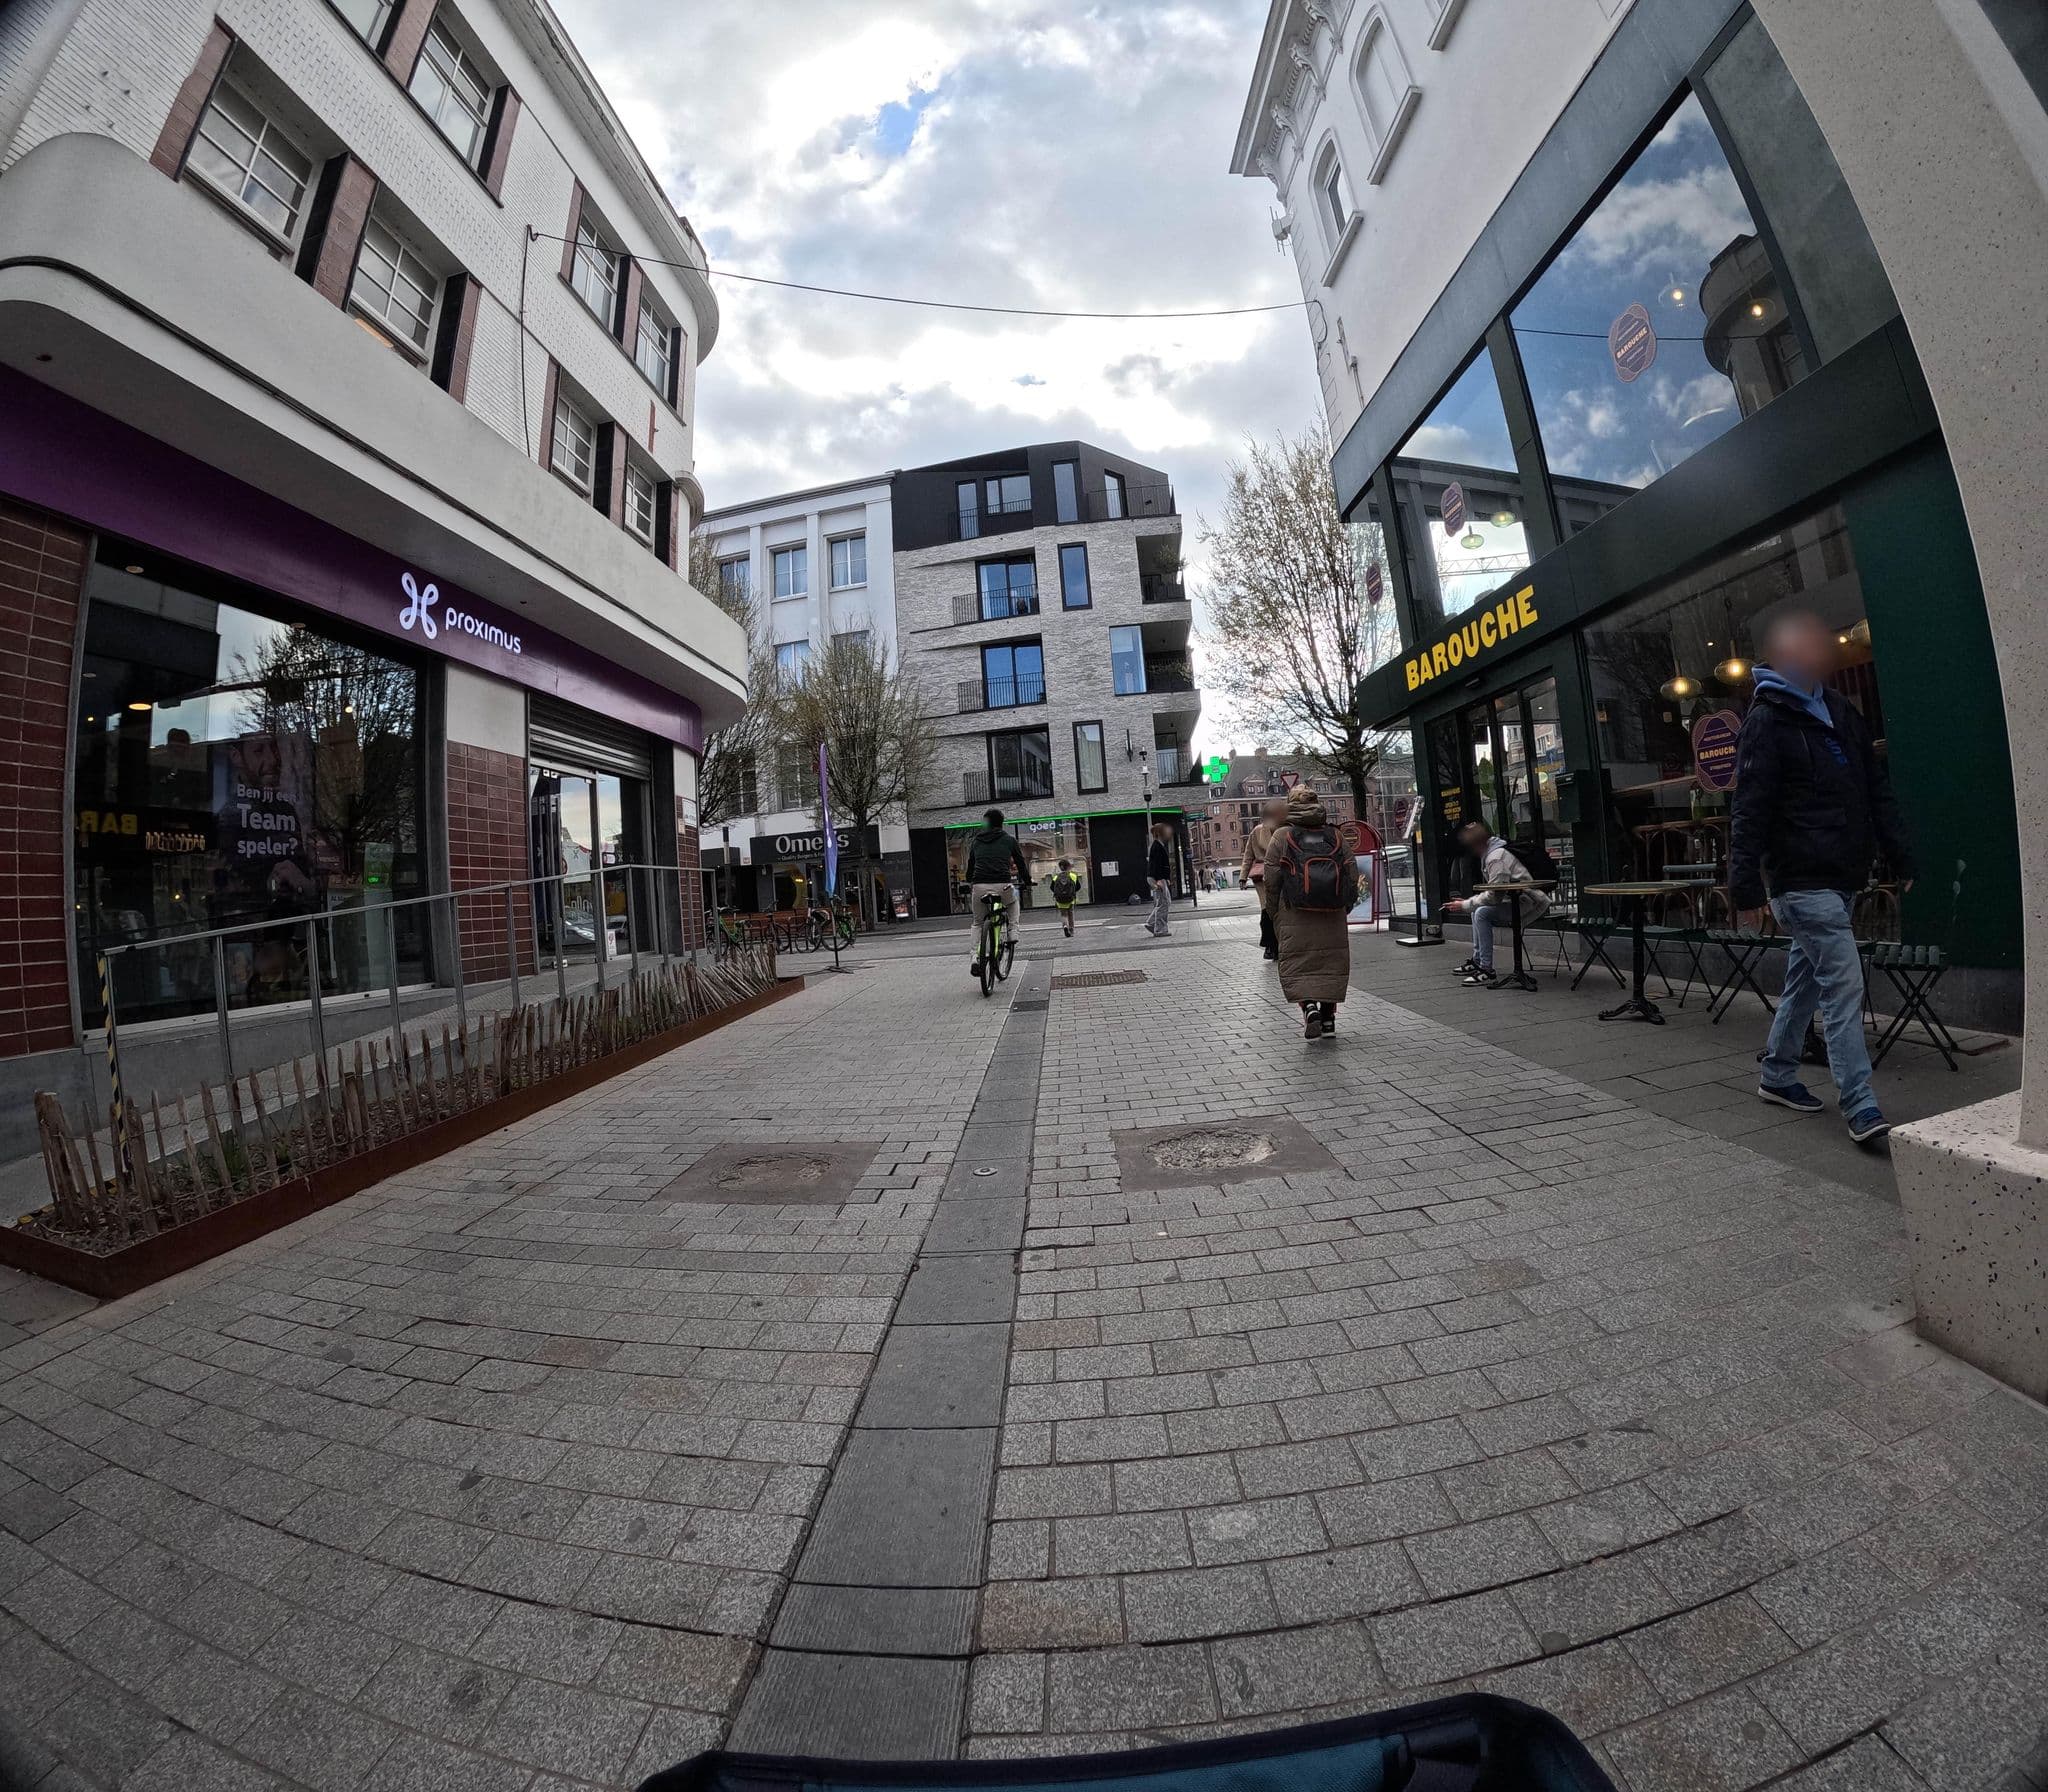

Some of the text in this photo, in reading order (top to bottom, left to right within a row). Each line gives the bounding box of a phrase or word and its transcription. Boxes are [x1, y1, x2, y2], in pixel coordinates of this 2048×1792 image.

[445, 607, 521, 654] proximus
[1405, 584, 1538, 692] BAROUCHE
[237, 783, 260, 799] Ben
[262, 786, 273, 803] jij
[236, 803, 296, 831] Team
[1029, 821, 1056, 833] goed
[237, 836, 298, 859] speler?
[775, 830, 850, 854] Ome's
